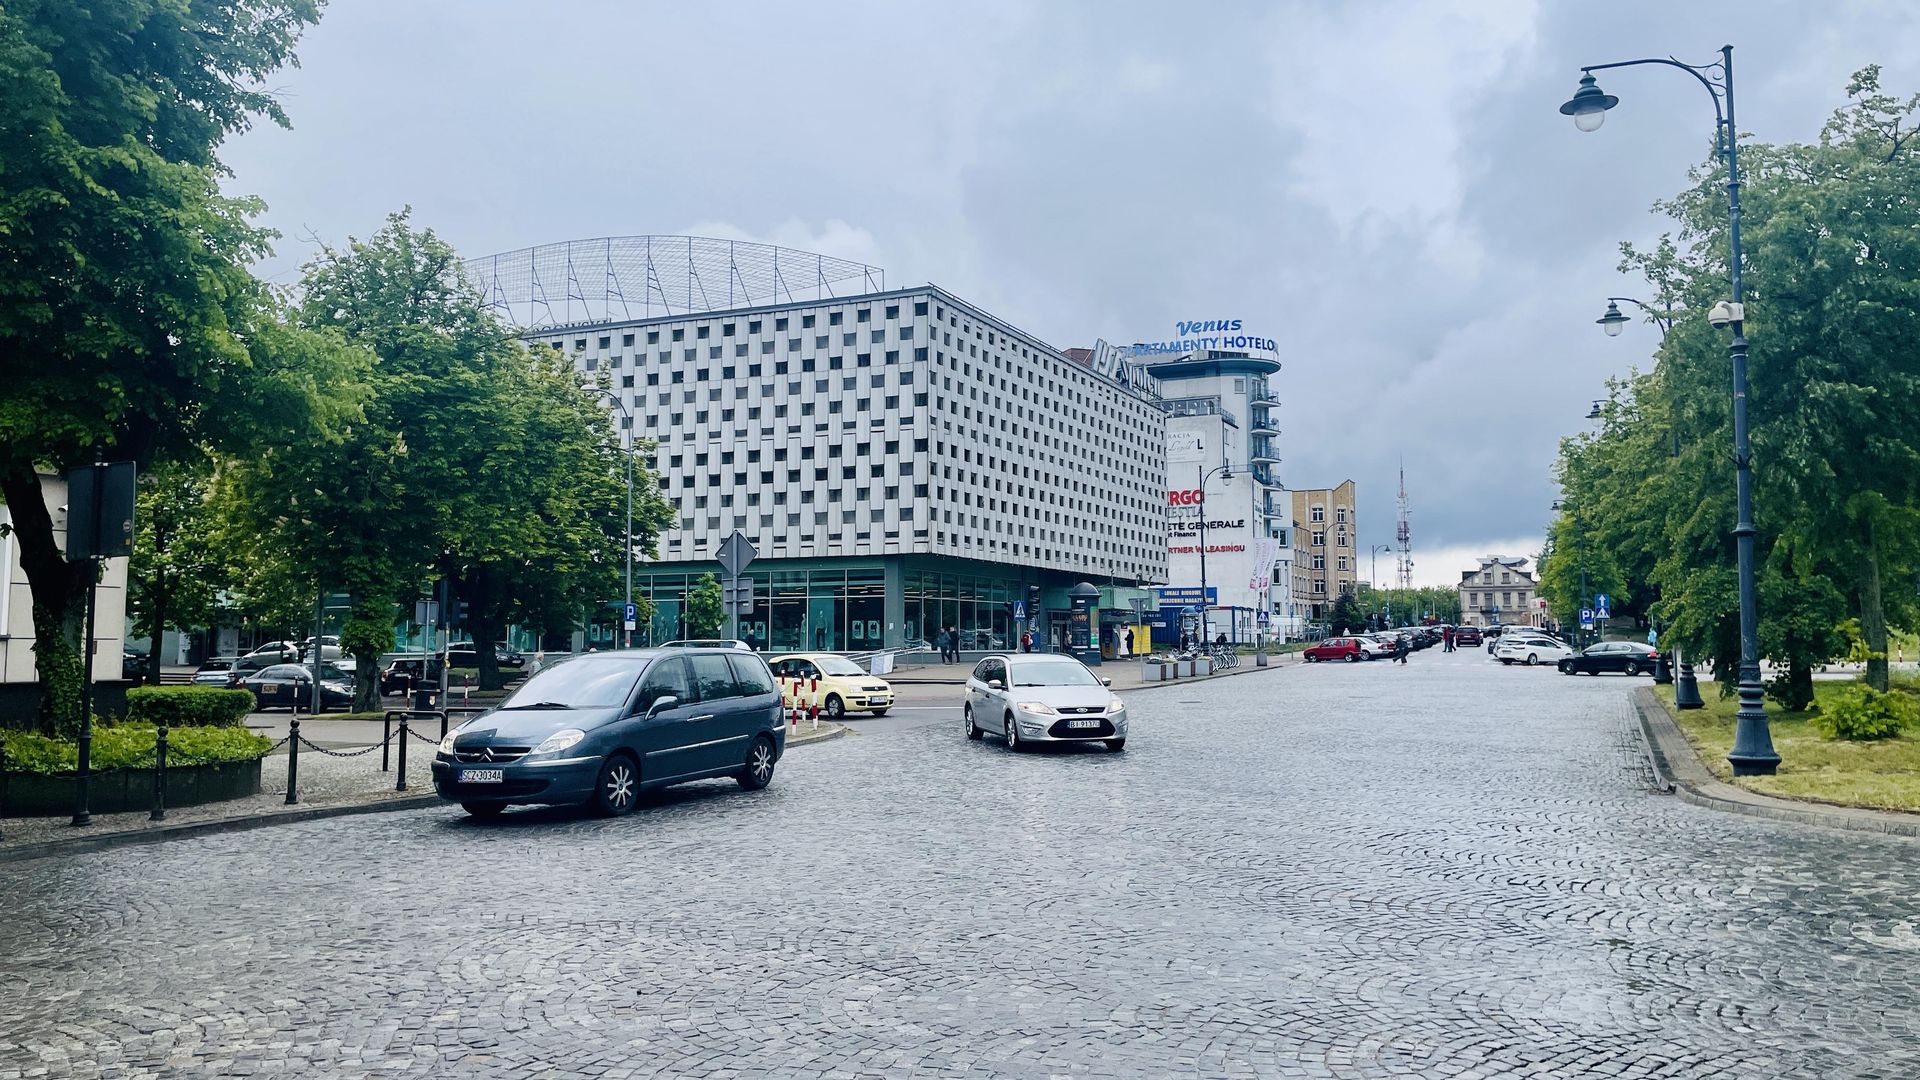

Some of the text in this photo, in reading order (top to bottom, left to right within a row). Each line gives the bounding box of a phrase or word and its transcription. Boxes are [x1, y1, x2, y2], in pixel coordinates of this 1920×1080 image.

[1168, 489, 1203, 506] RGO
[1187, 519, 1245, 531] GENERALE
[1205, 544, 1245, 553] LEASINGU
[626, 605, 634, 620] P
[1582, 610, 1590, 620] P
